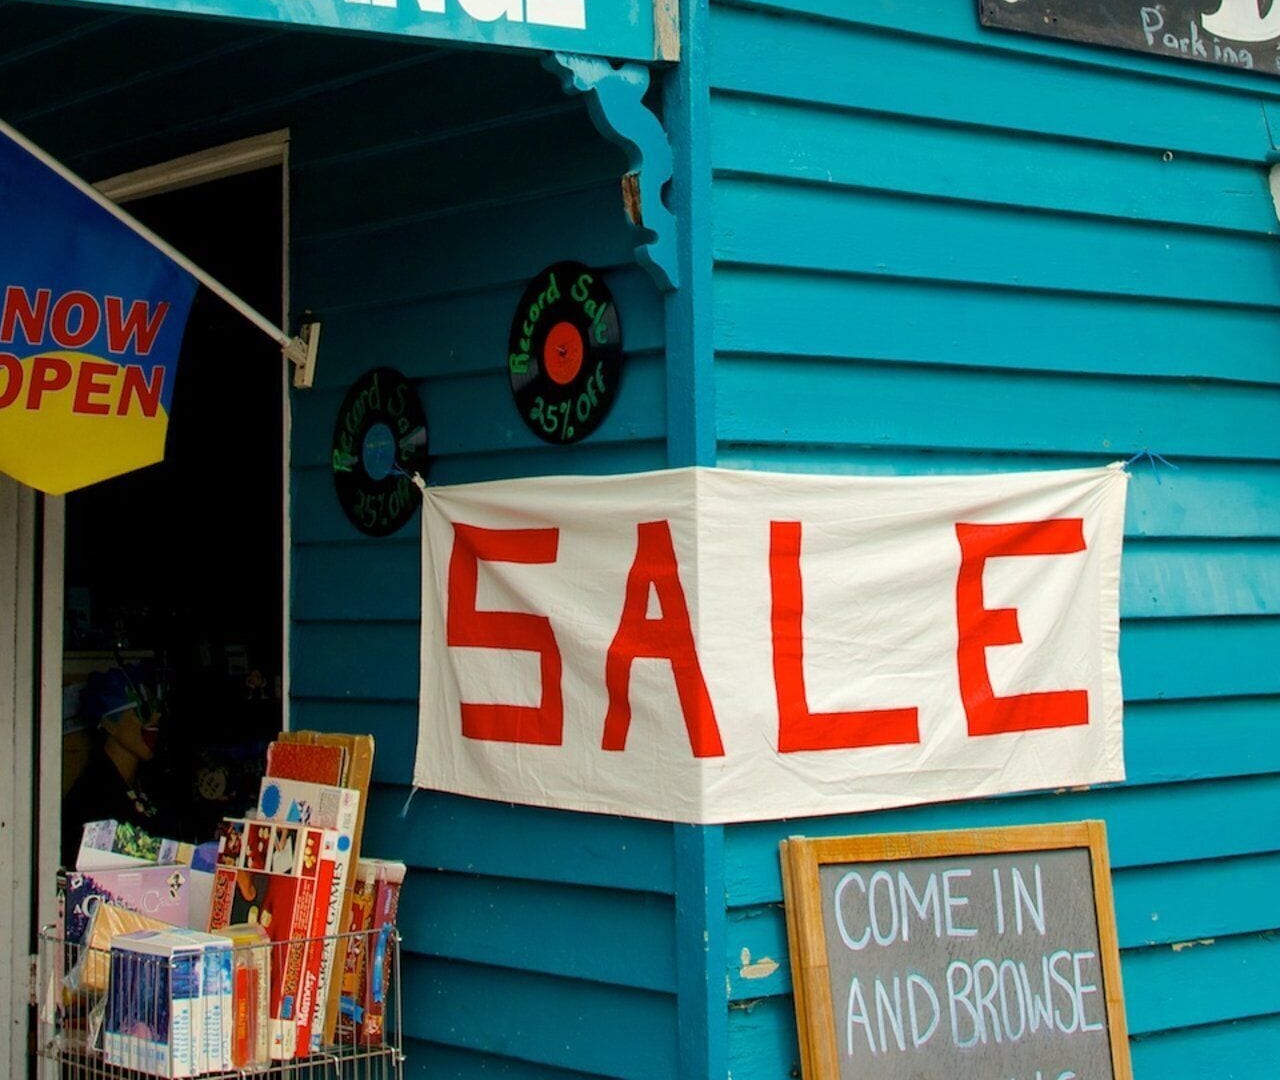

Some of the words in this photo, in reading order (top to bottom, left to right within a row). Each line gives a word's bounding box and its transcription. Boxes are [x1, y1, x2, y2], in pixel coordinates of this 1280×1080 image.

[1141, 6, 1254, 72] Parking
[509, 272, 561, 374] Record
[570, 274, 609, 344] Sale
[446, 517, 1089, 758] SALE
[834, 869, 978, 951] COME
[992, 863, 1047, 936] IN
[295, 969, 316, 1027] Memory
[847, 973, 941, 1057] AND
[946, 950, 1104, 1049] BROWSE
